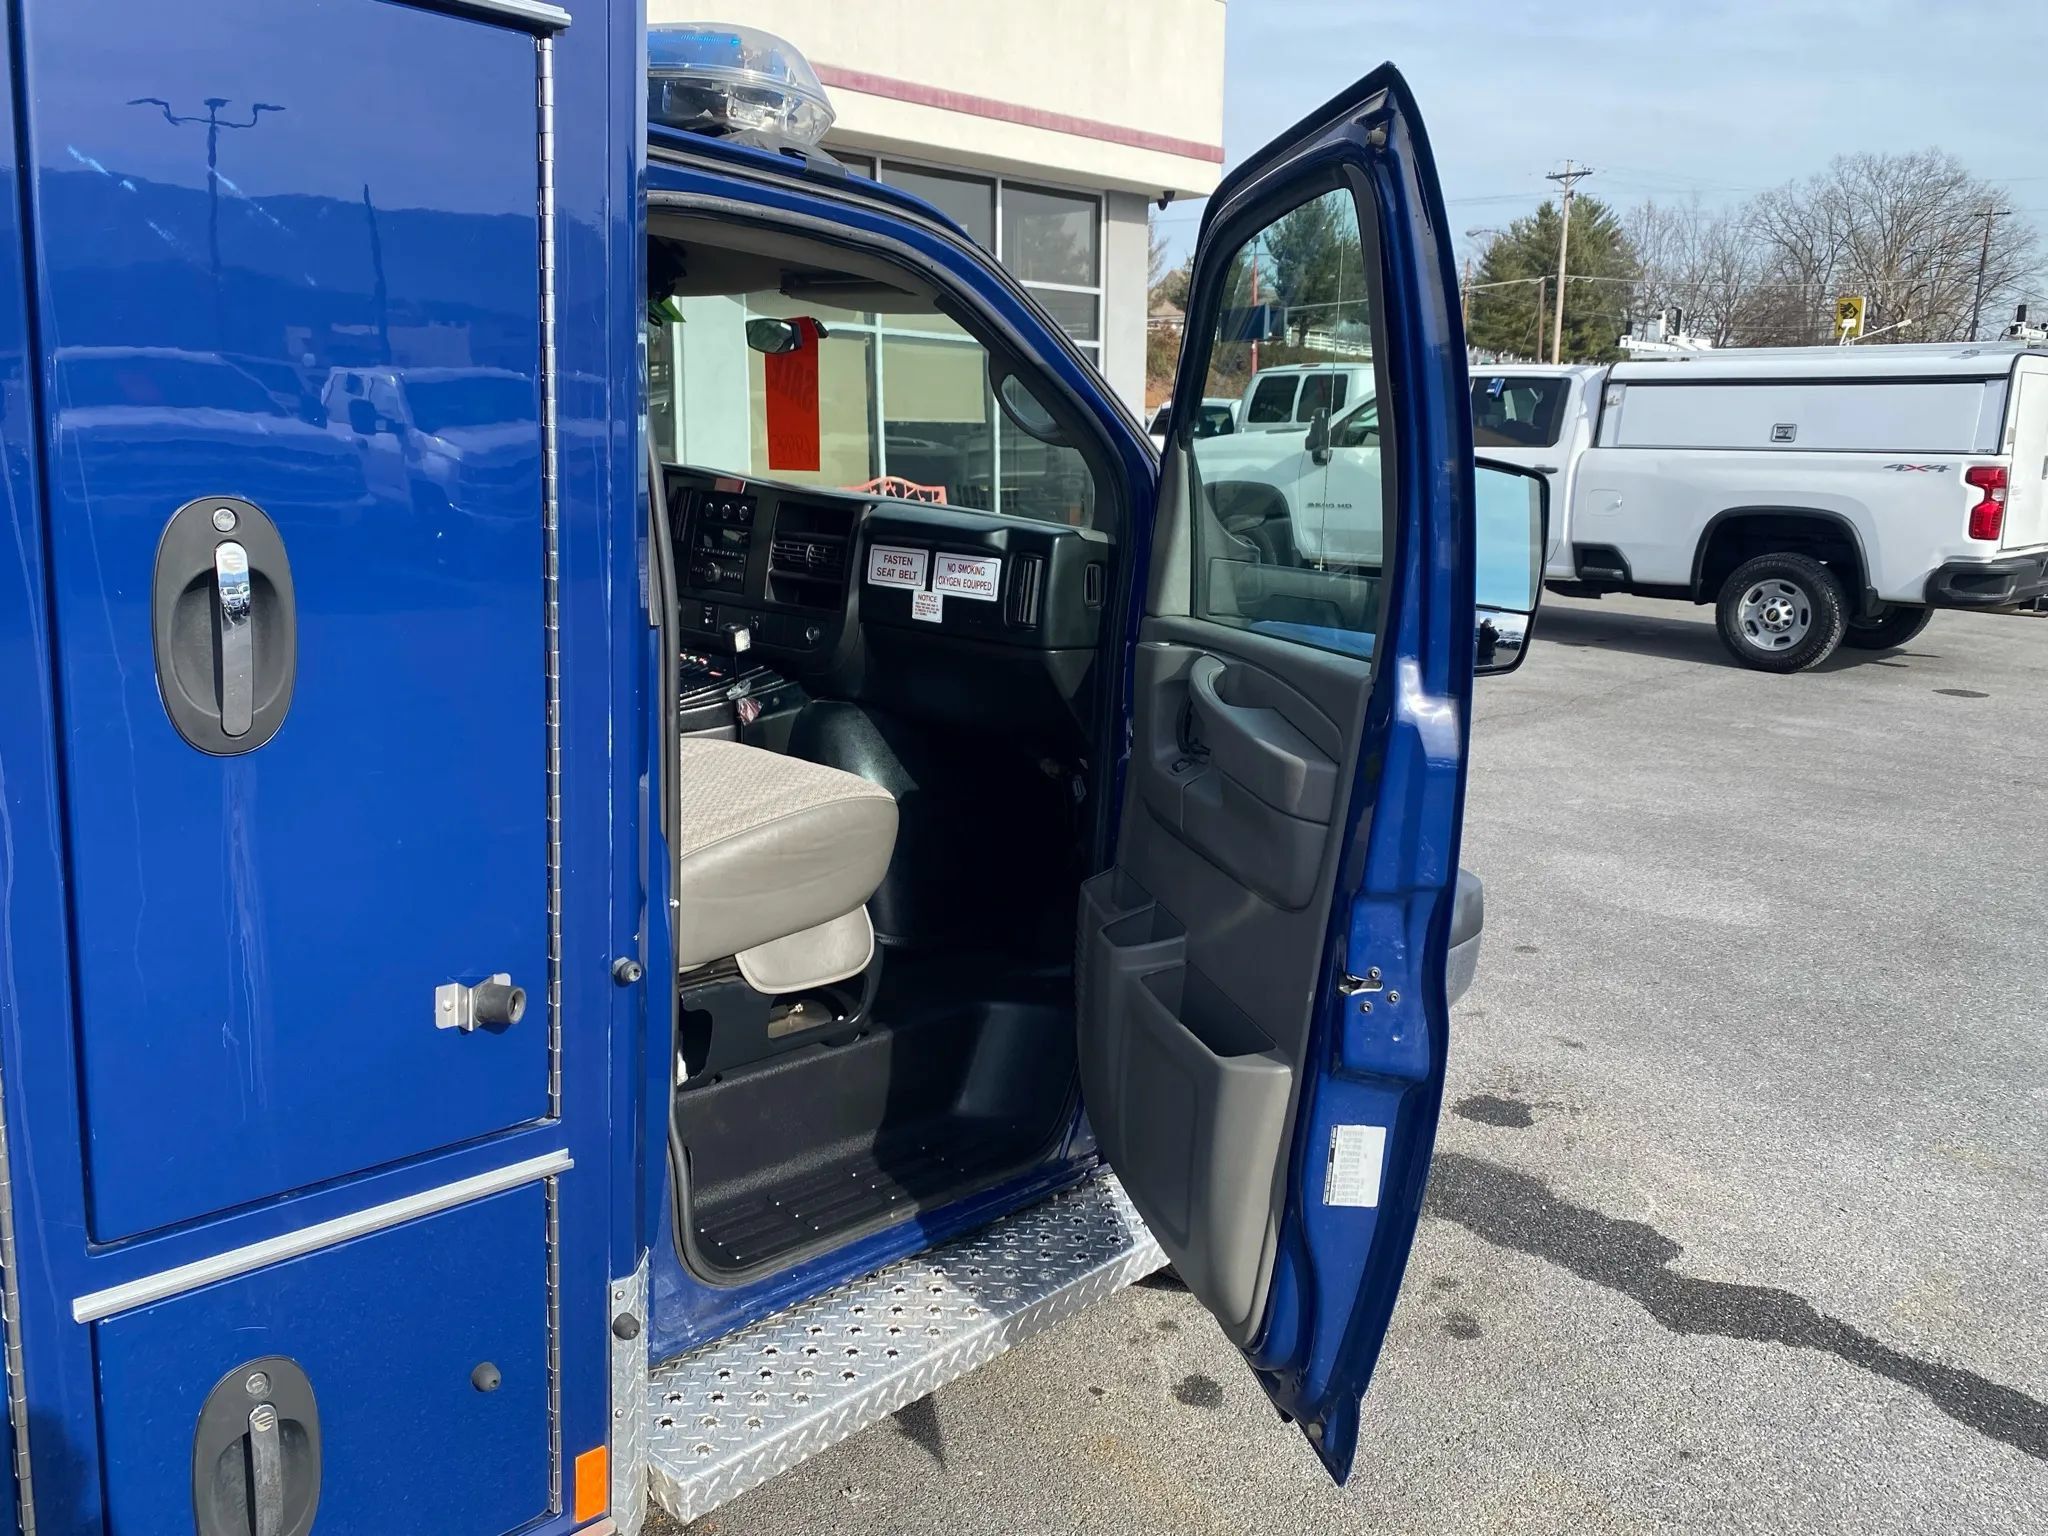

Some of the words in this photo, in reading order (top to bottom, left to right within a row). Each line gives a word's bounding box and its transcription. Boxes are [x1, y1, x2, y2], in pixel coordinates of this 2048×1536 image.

[884, 555, 913, 566] FASTEN
[876, 567, 895, 577] SEAT
[899, 569, 917, 580] BELT
[947, 563, 956, 573] NO
[957, 564, 986, 576] SMOKING
[938, 576, 961, 587] OXYGEN
[963, 578, 992, 591] EQUIPPED
[918, 594, 938, 603] NOTICE
